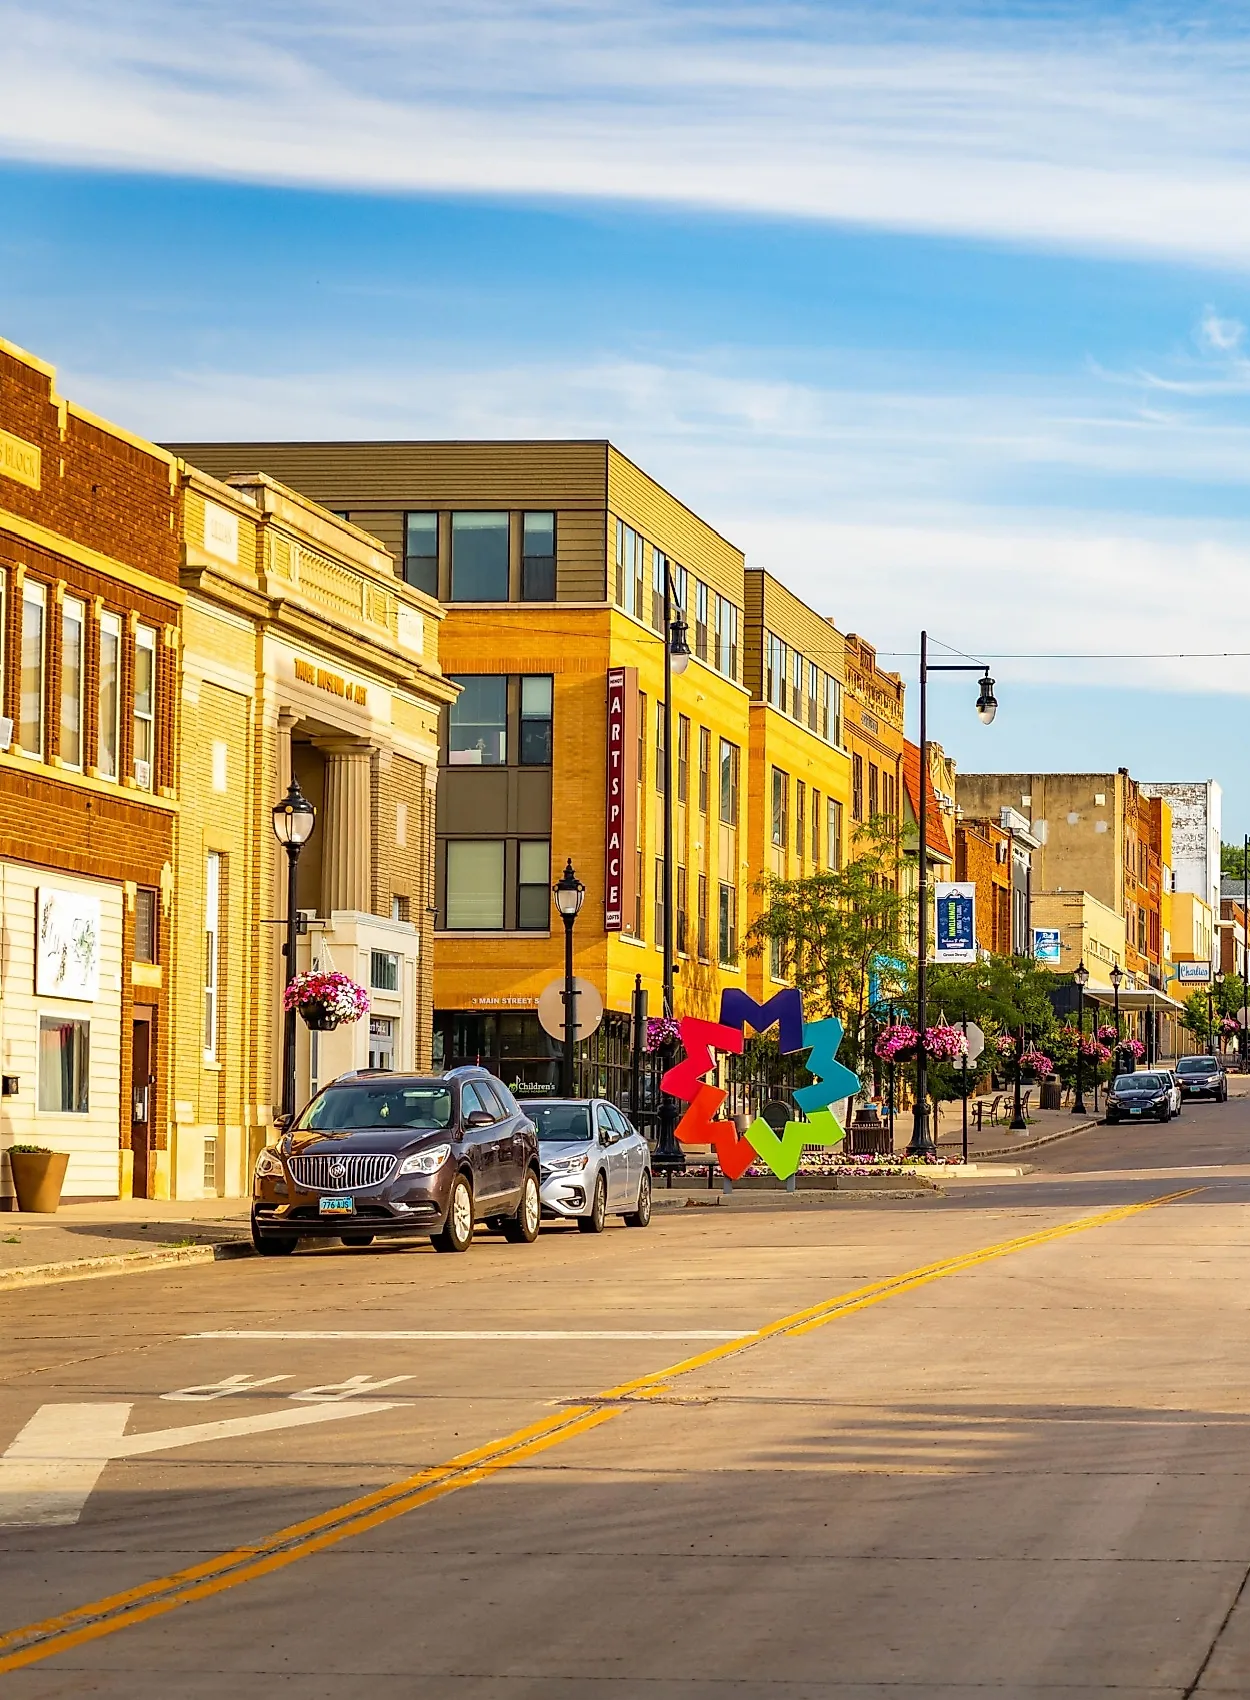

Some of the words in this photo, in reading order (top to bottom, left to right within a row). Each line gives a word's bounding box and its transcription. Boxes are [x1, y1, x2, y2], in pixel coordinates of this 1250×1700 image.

[317, 668, 344, 697] MUSEUM
[354, 684, 367, 706] ART
[609, 697, 621, 903] ARTSPACE
[948, 902, 956, 937] DOWNTOWN
[518, 1082, 556, 1090] Children's
[322, 1201, 335, 1209] 776
[336, 1201, 349, 1209] AJS
